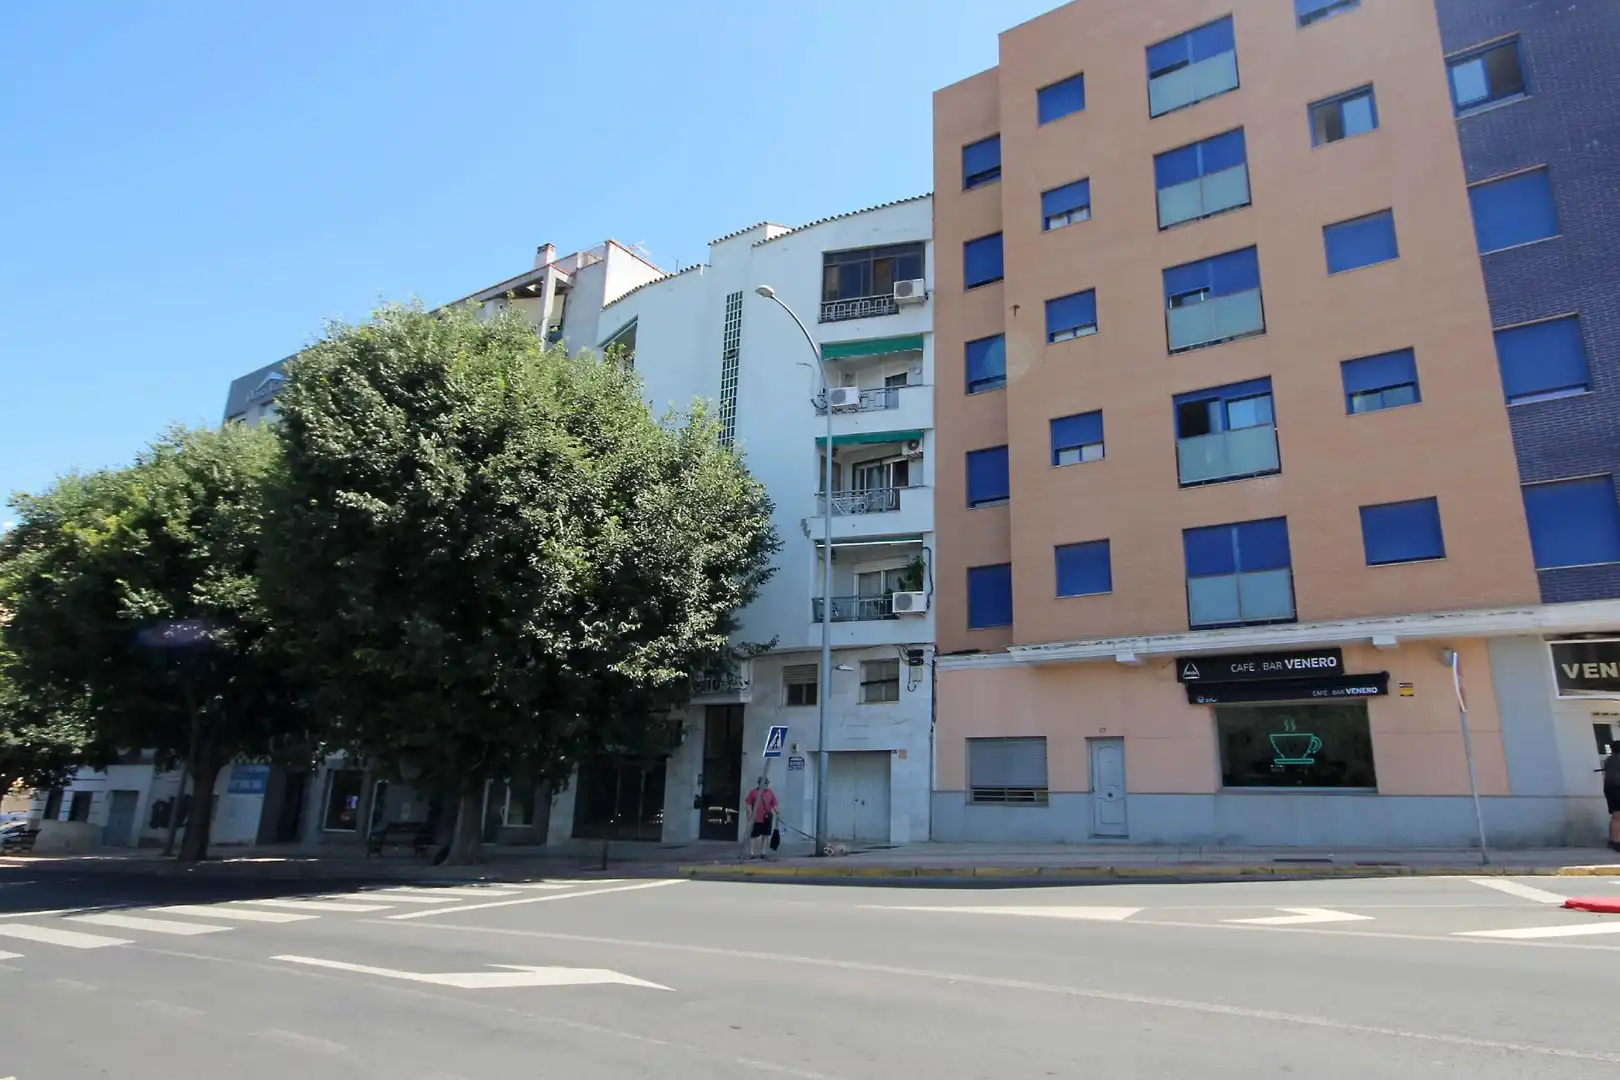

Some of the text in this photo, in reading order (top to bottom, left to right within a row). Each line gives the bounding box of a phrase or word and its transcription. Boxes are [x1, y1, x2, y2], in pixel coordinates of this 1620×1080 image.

[1263, 661, 1282, 671] BAR
[1284, 656, 1337, 669] VENERO
[1561, 662, 1620, 679] VEN
[1345, 686, 1378, 694] VENERO
